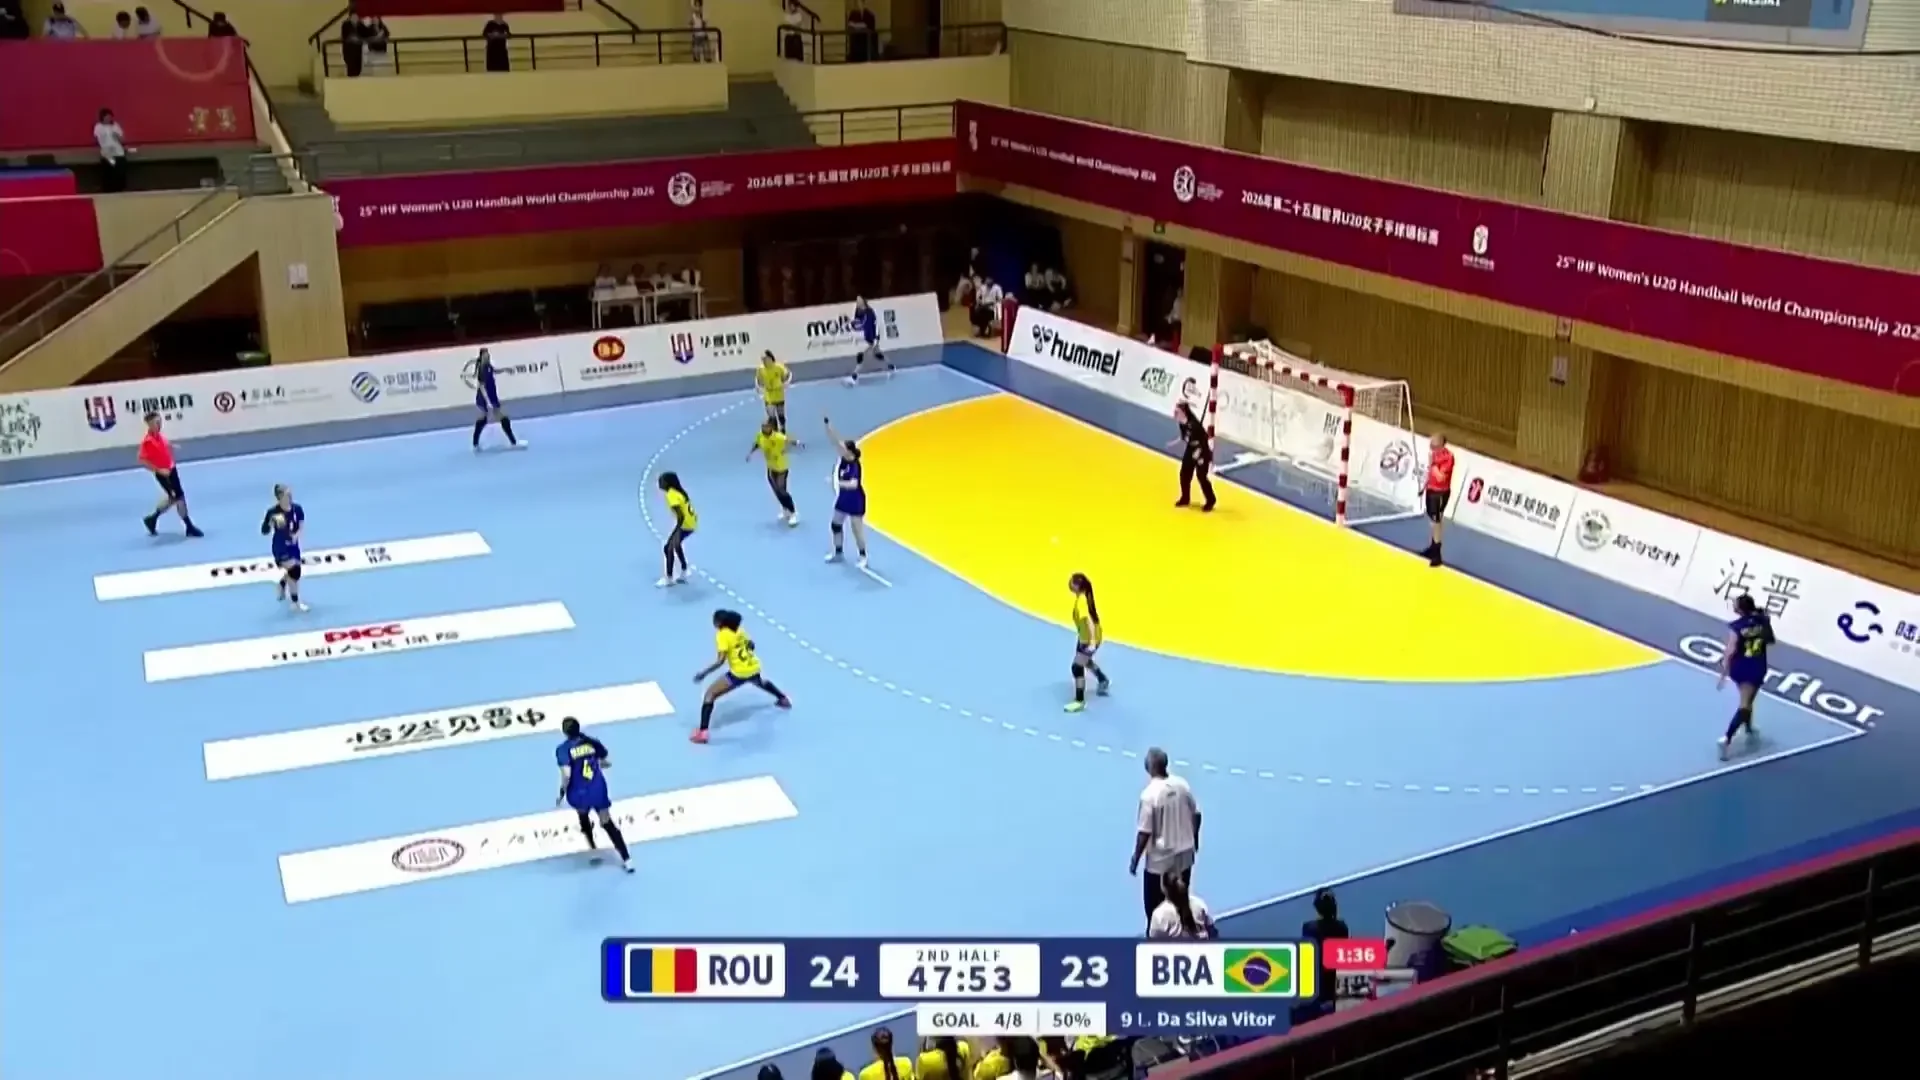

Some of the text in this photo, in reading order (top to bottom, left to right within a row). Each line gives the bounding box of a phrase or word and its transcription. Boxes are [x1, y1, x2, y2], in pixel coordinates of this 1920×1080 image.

[400, 201, 450, 214] Women's
[452, 199, 473, 210] U20
[475, 195, 523, 208] Handball
[525, 193, 556, 206] World
[558, 187, 629, 204] Championship
[631, 186, 655, 198] 2026
[1577, 259, 1596, 273] IHF
[1597, 262, 1650, 287] Women's
[1652, 274, 1677, 293] U20
[1679, 280, 1738, 305] Handball
[1741, 291, 1782, 313] World
[1784, 300, 1889, 337] Championship
[806, 314, 868, 338] molte
[1050, 331, 1121, 377] hummel
[1487, 484, 1561, 522] 中国手球协会
[1679, 634, 1885, 725] Grflor
[582, 759, 594, 781] 4
